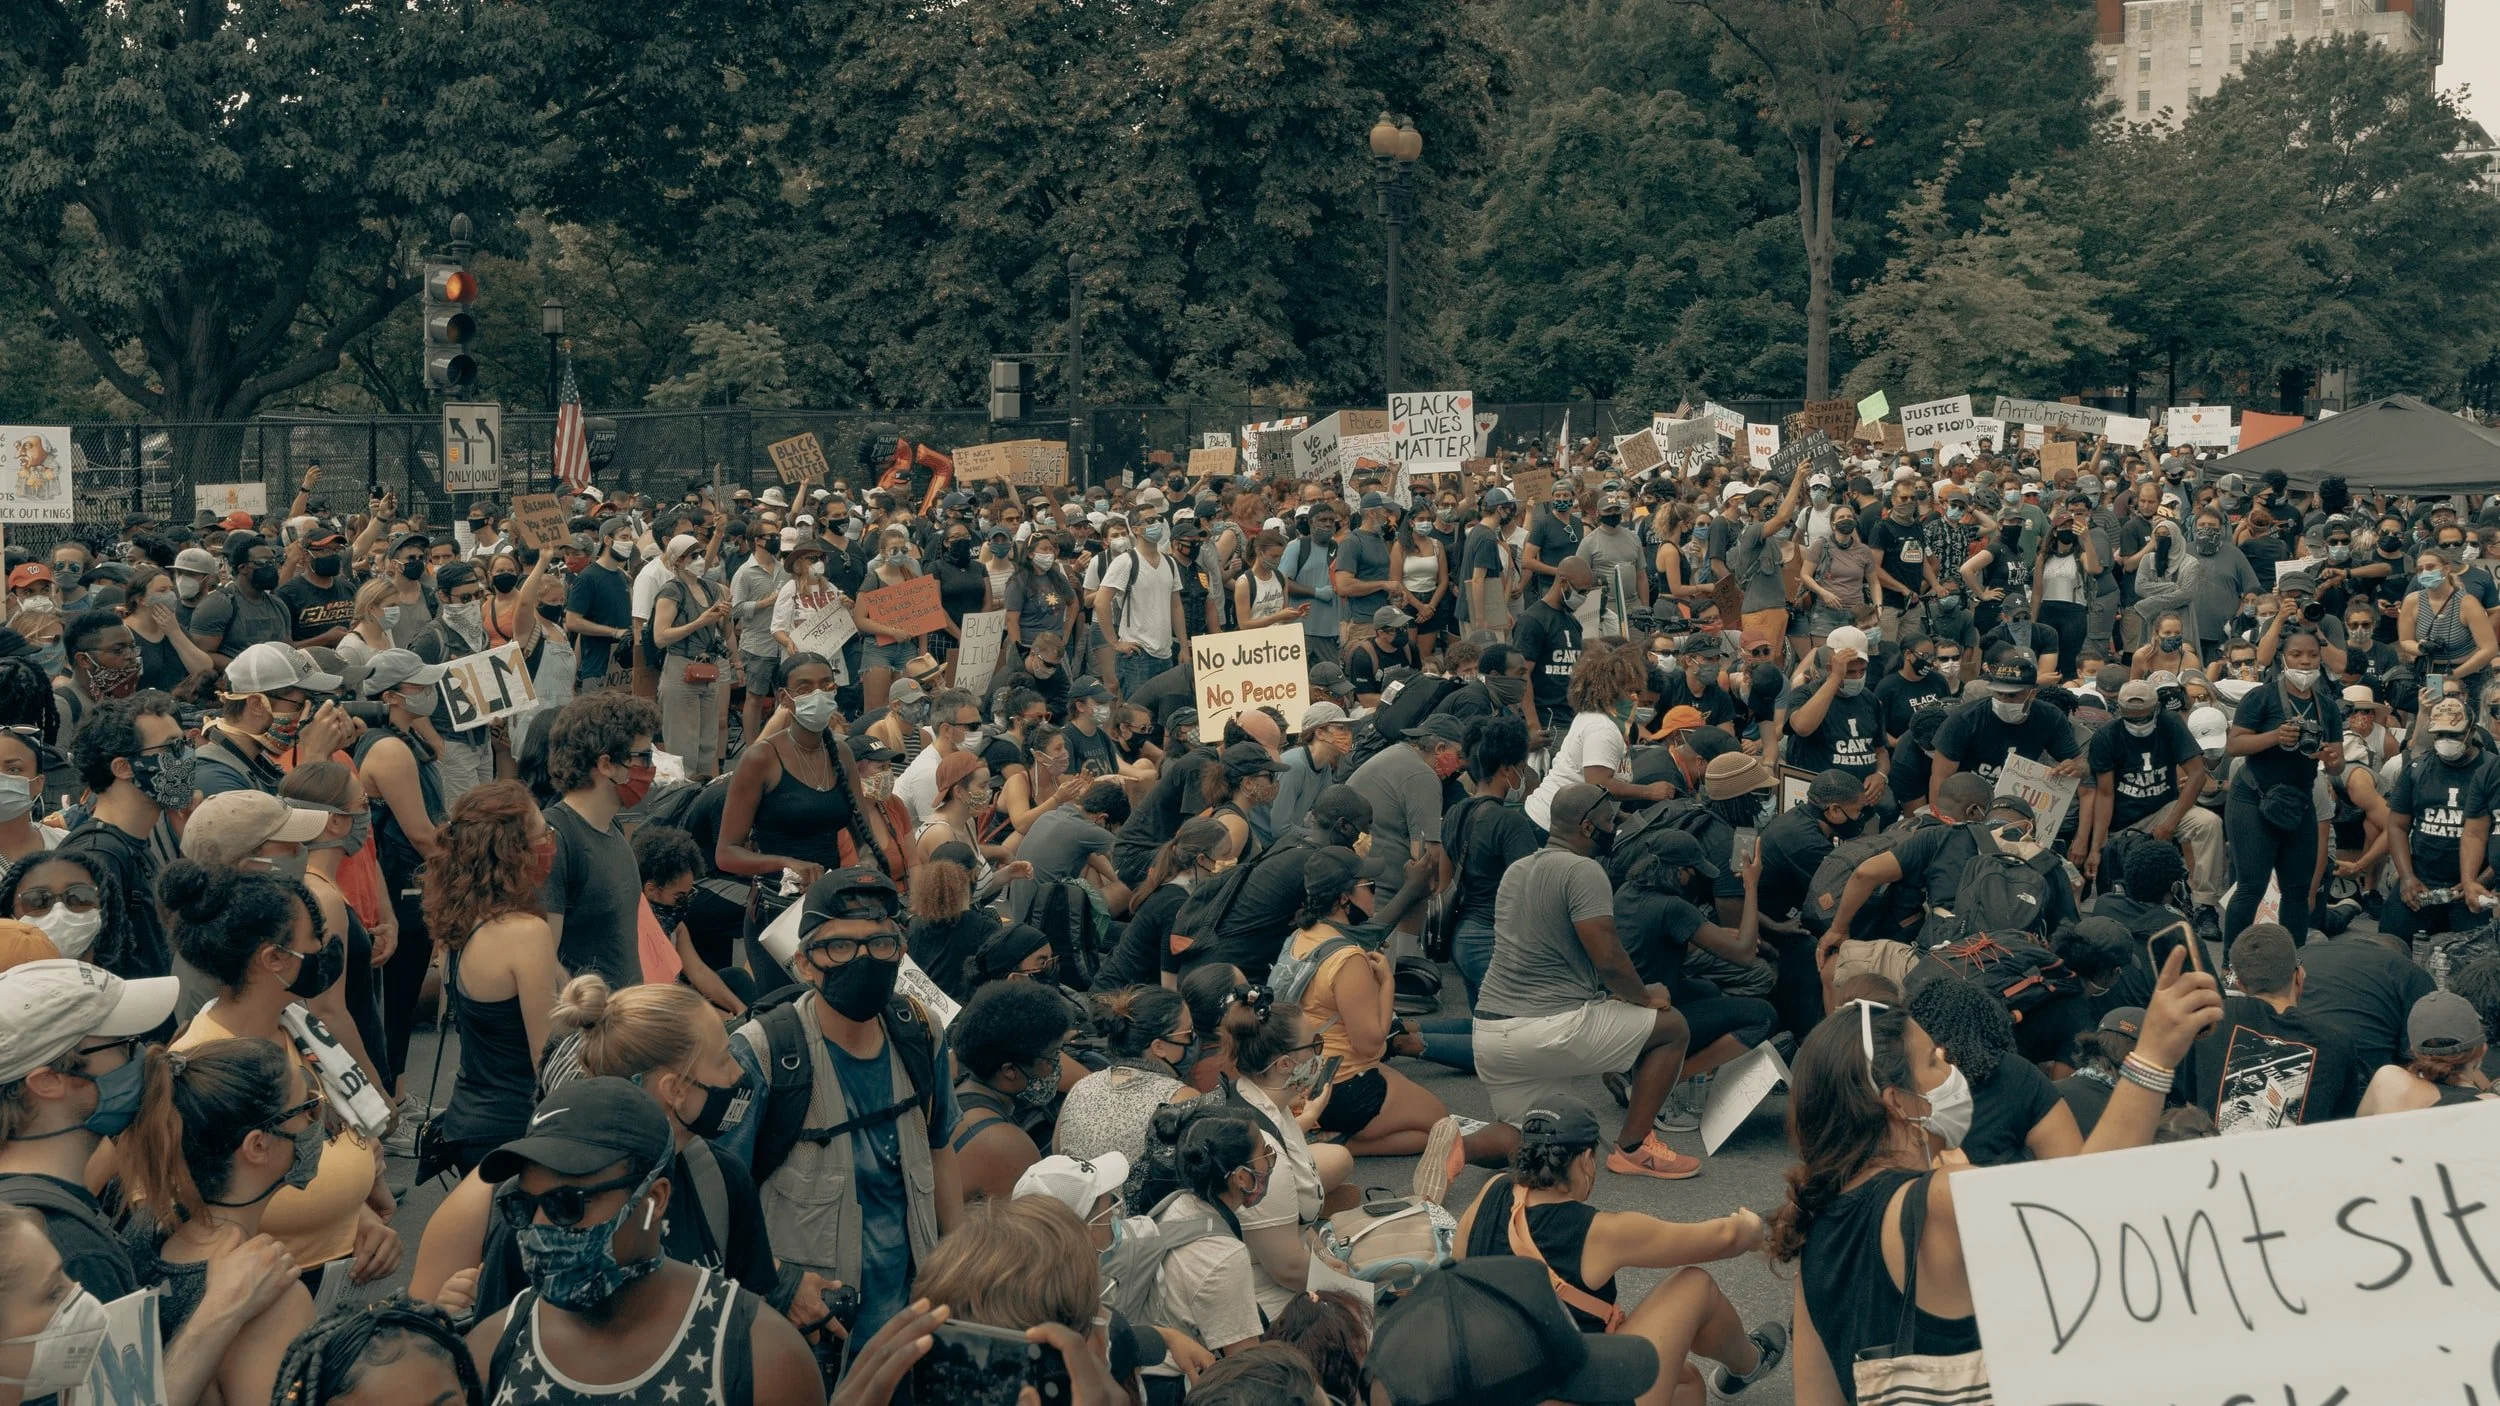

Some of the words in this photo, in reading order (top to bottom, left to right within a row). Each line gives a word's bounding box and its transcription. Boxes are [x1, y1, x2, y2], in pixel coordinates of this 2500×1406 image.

[1393, 394, 1459, 421] BLACK
[1806, 401, 1853, 412] GENERAL
[1904, 402, 1960, 421] JUSTICE
[1348, 412, 1383, 429] Police
[1408, 415, 1462, 436] LIVES
[1807, 412, 1853, 425] STRIKE
[1907, 424, 1933, 438] FOR
[1937, 418, 1975, 433] FLOYD
[1755, 426, 1771, 436] NO
[1976, 425, 1998, 433] STEMIC
[775, 435, 817, 459] BLACK
[1303, 434, 1321, 452] We
[1311, 434, 1338, 465] Stand
[1395, 435, 1472, 461] MATTER
[1624, 434, 1650, 455] BLACK
[1677, 444, 1710, 460] BACK
[1755, 446, 1772, 455] NO
[781, 449, 821, 472] LIVES
[1027, 459, 1062, 473] POLICE
[448, 470, 471, 483] ONLY
[474, 469, 498, 482] ONLY
[786, 461, 828, 483] MATTER
[1010, 471, 1061, 485] OVERSIGHT
[19, 508, 40, 519] OUT
[42, 508, 71, 519] KINGS
[548, 526, 562, 541] 27
[811, 619, 833, 639] REAL
[966, 616, 1006, 638] BLACK
[1564, 630, 1572, 648] I
[961, 641, 1001, 666] LIVES
[1197, 647, 1225, 671] No
[1232, 640, 1301, 666] Justice
[1545, 664, 1573, 676] BREA
[442, 648, 537, 725] BLM
[1207, 684, 1234, 709] No
[1241, 680, 1297, 703] Peace
[1909, 694, 1939, 707] BLACK
[1848, 718, 1859, 738] I
[2141, 751, 2153, 772] I
[2448, 787, 2459, 808] I
[2010, 1159, 2307, 1355] Don't
[2335, 1156, 2500, 1293] sit
